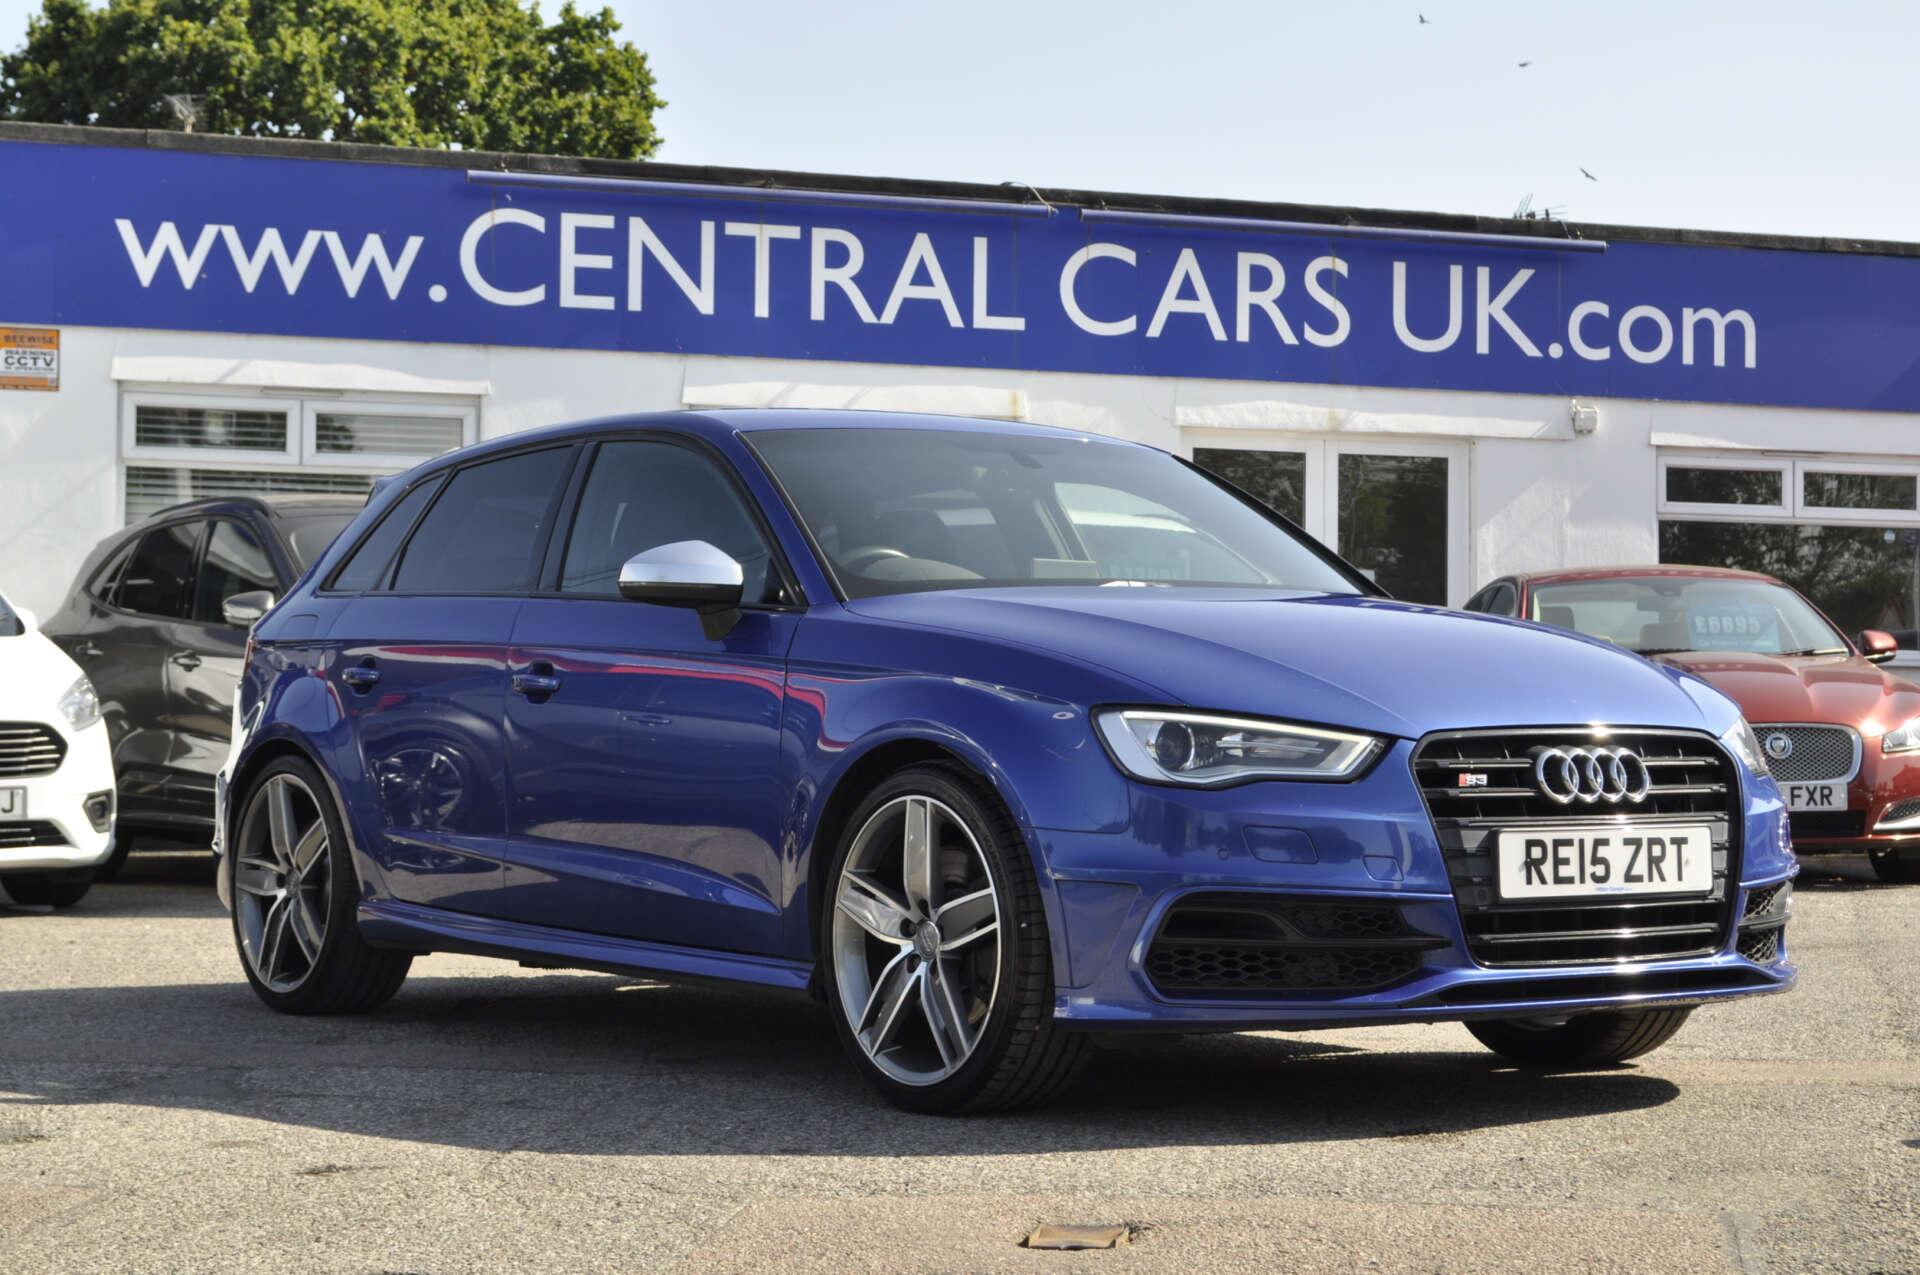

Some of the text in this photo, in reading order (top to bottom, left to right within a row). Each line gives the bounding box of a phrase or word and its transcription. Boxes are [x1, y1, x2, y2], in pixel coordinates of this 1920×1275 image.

[1060, 243, 1351, 348] CARS
[1392, 261, 1757, 369] UK.com
[4, 356, 55, 367] CCTV
[1790, 785, 1833, 807] FXR
[1524, 836, 1689, 885] RE15 ZRT
